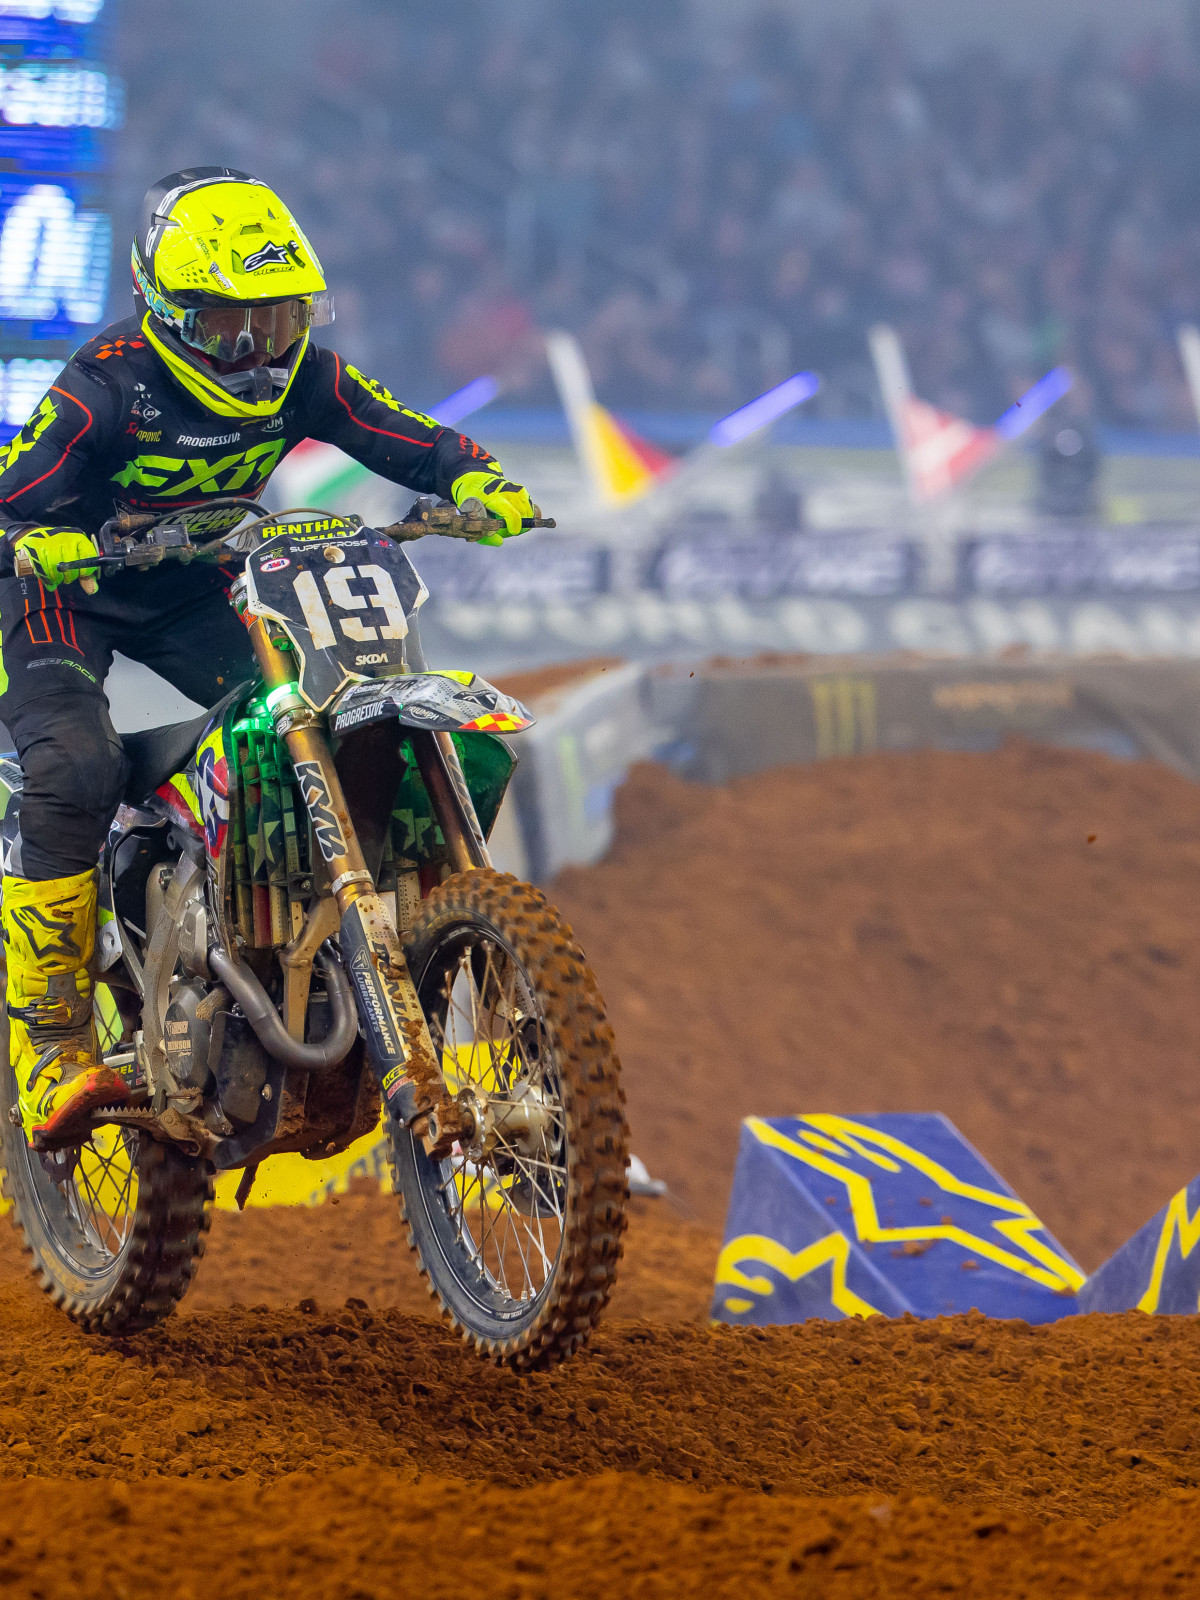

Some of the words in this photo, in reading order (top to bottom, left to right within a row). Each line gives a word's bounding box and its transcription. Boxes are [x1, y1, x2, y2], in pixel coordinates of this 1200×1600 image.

[159, 506, 246, 525] TRIUM
[289, 539, 369, 553] SUPERCROSS
[292, 563, 409, 651] 19
[354, 653, 389, 666] SKDA
[334, 700, 387, 731] PROGRESSIVE
[355, 971, 380, 1033] LUBRICANTS
[362, 971, 396, 1055] PERFORMANCE
